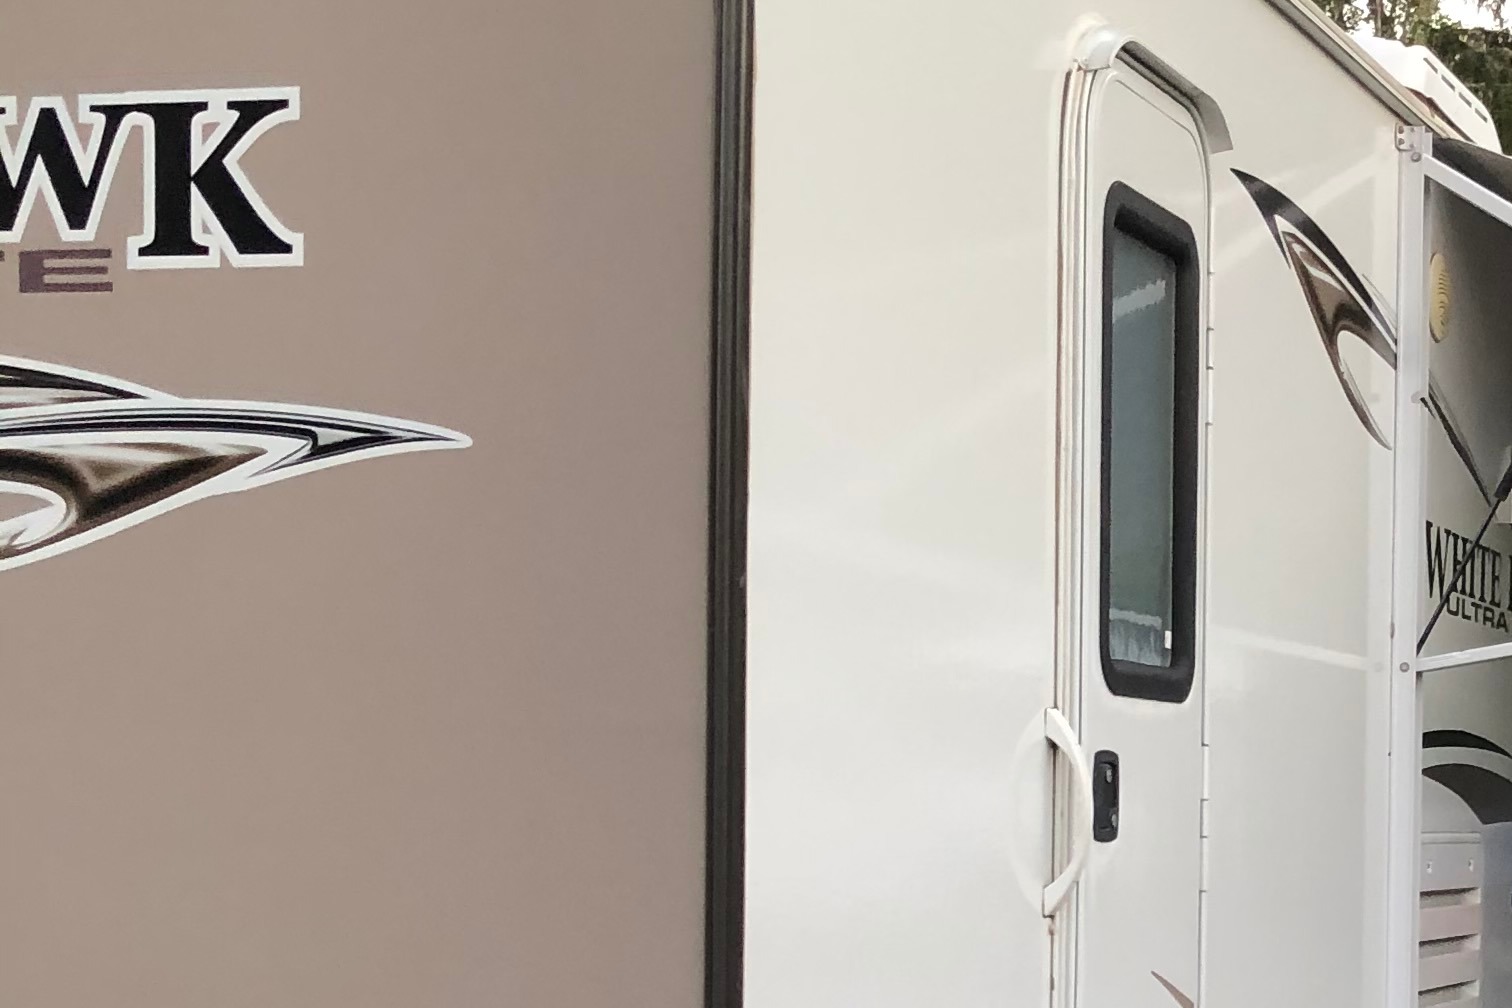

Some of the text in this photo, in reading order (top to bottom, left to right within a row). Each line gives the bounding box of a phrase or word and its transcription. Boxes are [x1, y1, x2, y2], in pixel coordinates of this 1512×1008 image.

[0, 249, 113, 293] E
[1426, 520, 1502, 608] WHITE
[1446, 594, 1508, 633] ULTRA
